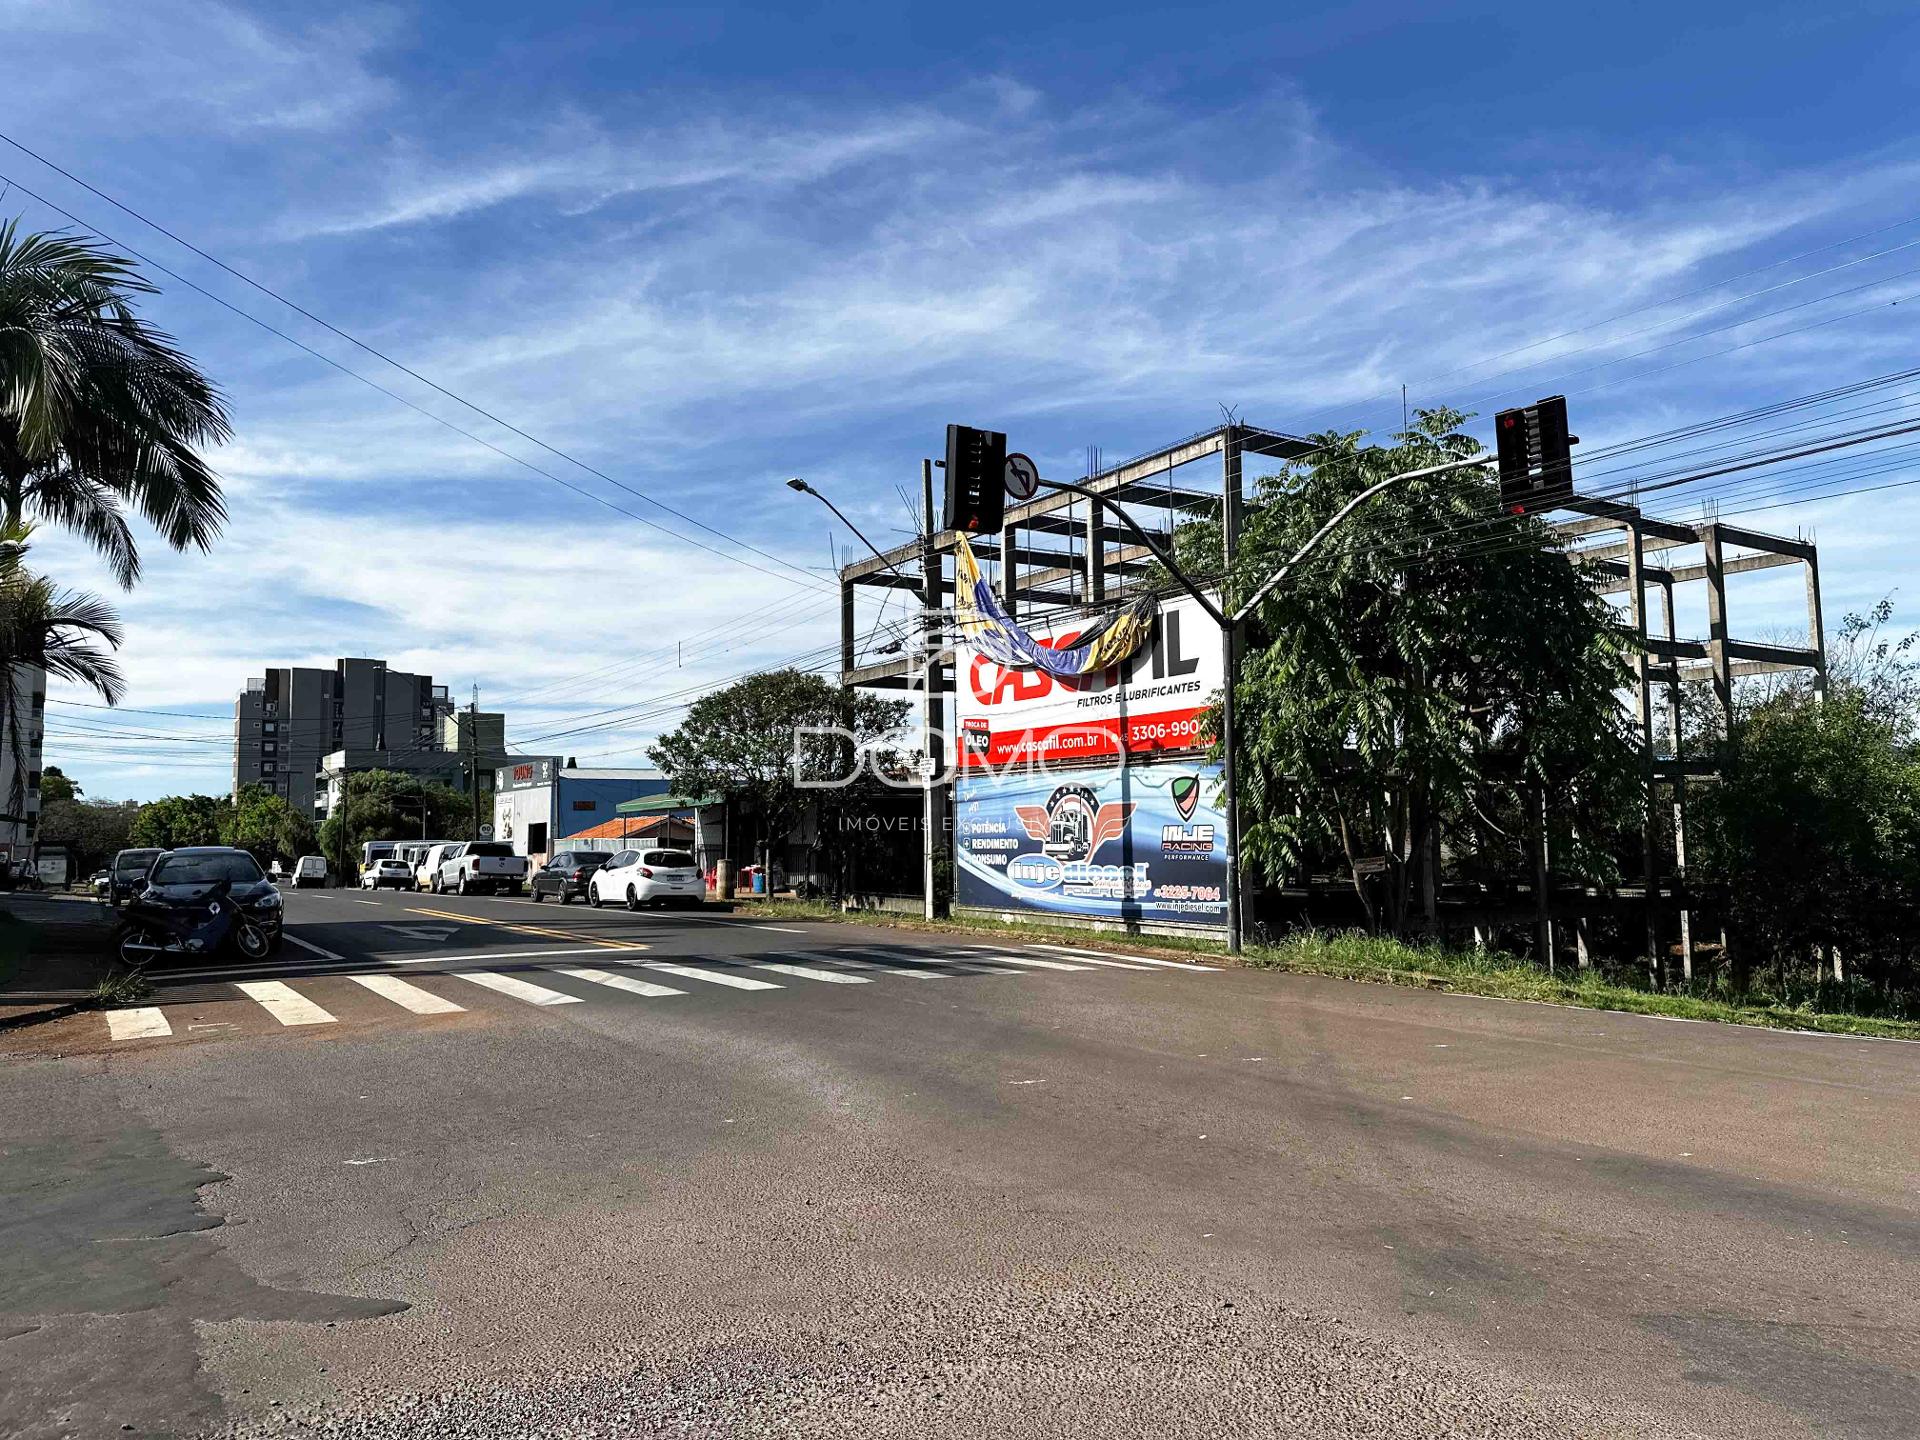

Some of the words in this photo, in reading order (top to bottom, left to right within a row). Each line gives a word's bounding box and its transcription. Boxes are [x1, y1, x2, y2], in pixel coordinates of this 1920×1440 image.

[1077, 693, 1113, 708] FILTROS
[1114, 692, 1121, 703] E
[1122, 681, 1201, 701] LUBRIFICANTES
[966, 732, 989, 748] ÓLEO
[997, 733, 1099, 754] www.cascafil.com.br
[971, 821, 1007, 834] POTÊNCIA
[1163, 825, 1213, 841] INJE
[971, 838, 1019, 849] RENDIMENTO
[1161, 842, 1213, 851] RACING
[971, 853, 1008, 865] CONSUMO
[1013, 861, 1061, 884] inje
[1062, 862, 1146, 883] diesel
[1064, 886, 1109, 897] POWER
[1160, 885, 1220, 901] 3225-7064
[1155, 900, 1220, 914] www.injediesel.com
